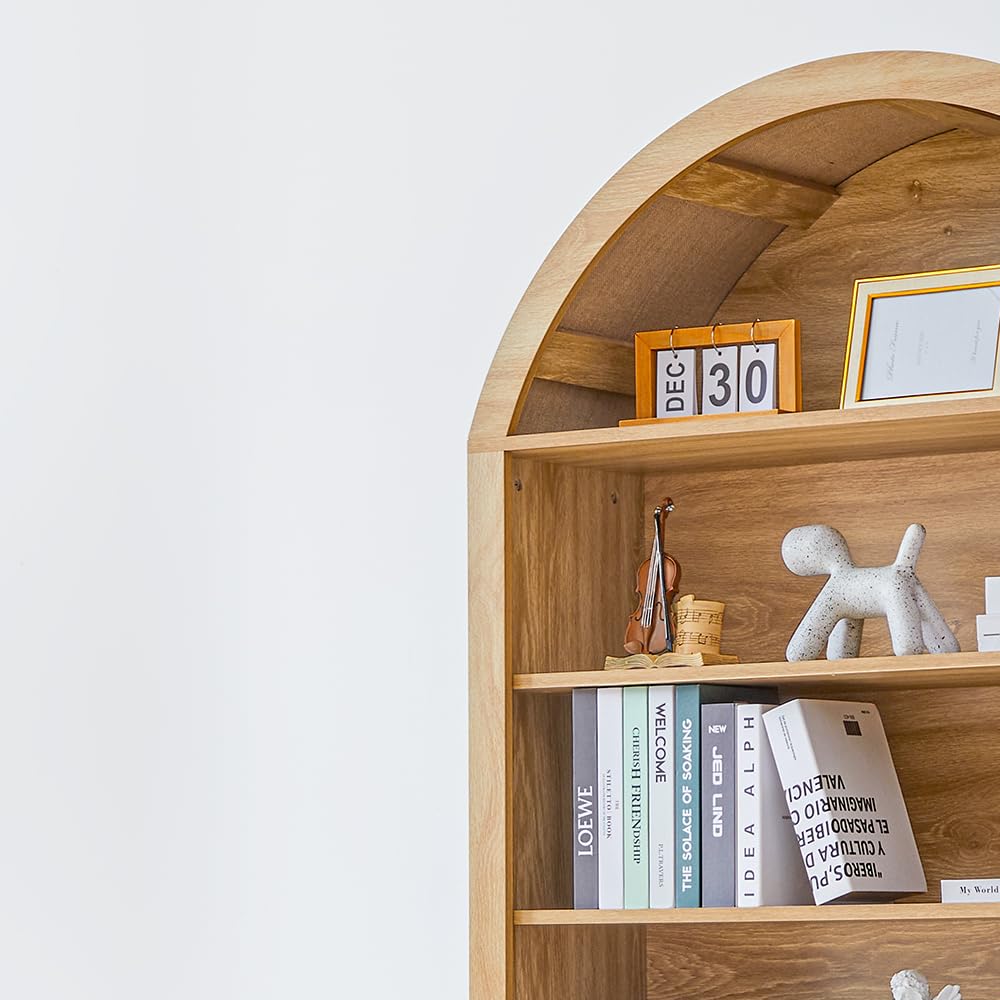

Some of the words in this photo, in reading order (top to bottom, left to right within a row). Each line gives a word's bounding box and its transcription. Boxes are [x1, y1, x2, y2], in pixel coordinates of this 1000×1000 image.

[665, 362, 686, 412] DEC
[655, 703, 667, 784] WELCOME
[682, 718, 692, 780] SOAKING
[708, 724, 728, 734] NEW
[631, 726, 641, 780] CHERISH
[712, 745, 723, 785] JED
[744, 716, 755, 797] ALPH
[682, 785, 692, 804] OF
[785, 774, 846, 803] VALENCI
[804, 797, 877, 820] IMAGINARIO
[577, 785, 594, 857] LOEWE
[631, 784, 642, 864] FRIENDSHIP
[682, 808, 692, 861] SOLACE
[712, 793, 723, 838] LIND
[831, 818, 875, 834] PASADO
[876, 819, 890, 834] EL
[744, 823, 755, 897] IDEA
[820, 840, 875, 863] CULTURA
[878, 840, 886, 856] Y
[682, 865, 692, 892] THE
[959, 885, 972, 896] My
[973, 885, 1000, 894] World
